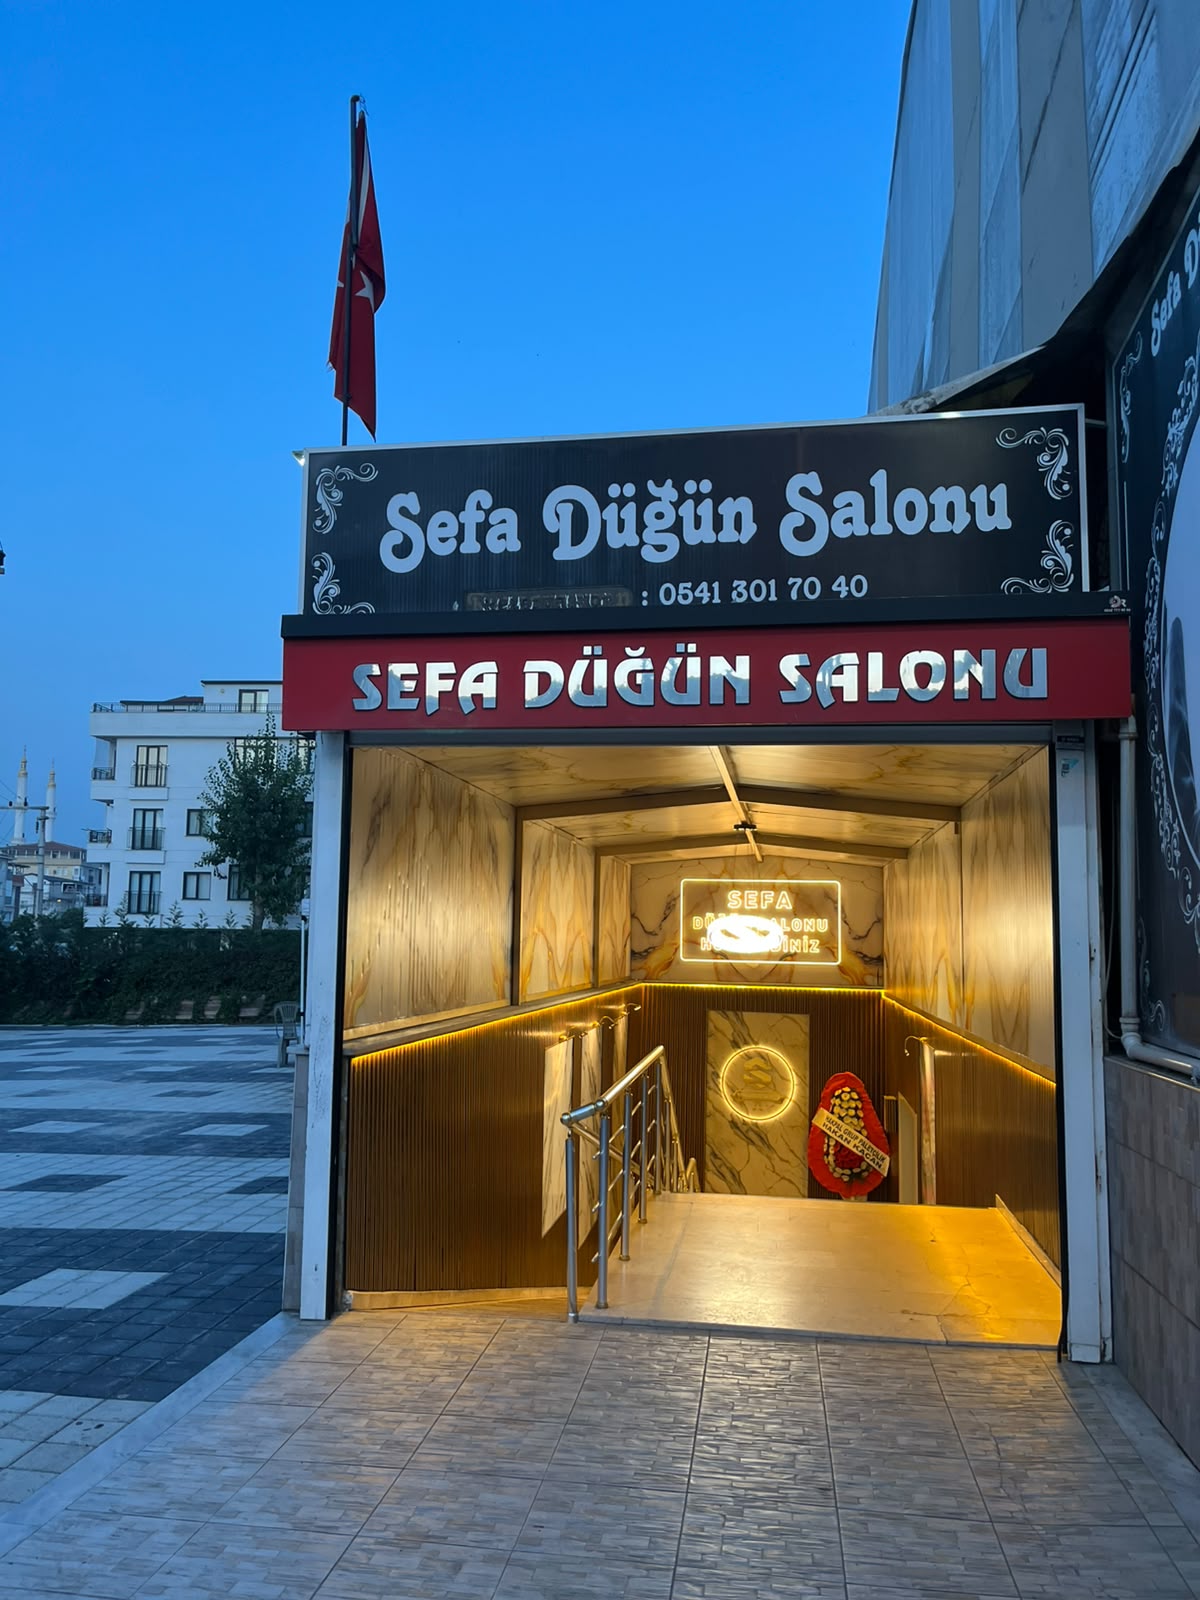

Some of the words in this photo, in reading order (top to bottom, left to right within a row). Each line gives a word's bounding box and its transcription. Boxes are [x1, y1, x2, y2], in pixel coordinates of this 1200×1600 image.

[1150, 269, 1182, 358] Sefa
[379, 489, 522, 574] Sefa
[542, 478, 758, 563] Düğün
[778, 469, 1012, 557] Salonu
[658, 580, 722, 606] 0541
[731, 578, 778, 603] 301
[787, 575, 822, 600] 70
[831, 574, 869, 599] 40
[351, 660, 499, 717] SEFA
[522, 642, 752, 709] DÜĞÜN
[778, 647, 1049, 710] SALONU
[727, 889, 793, 910] SEFA
